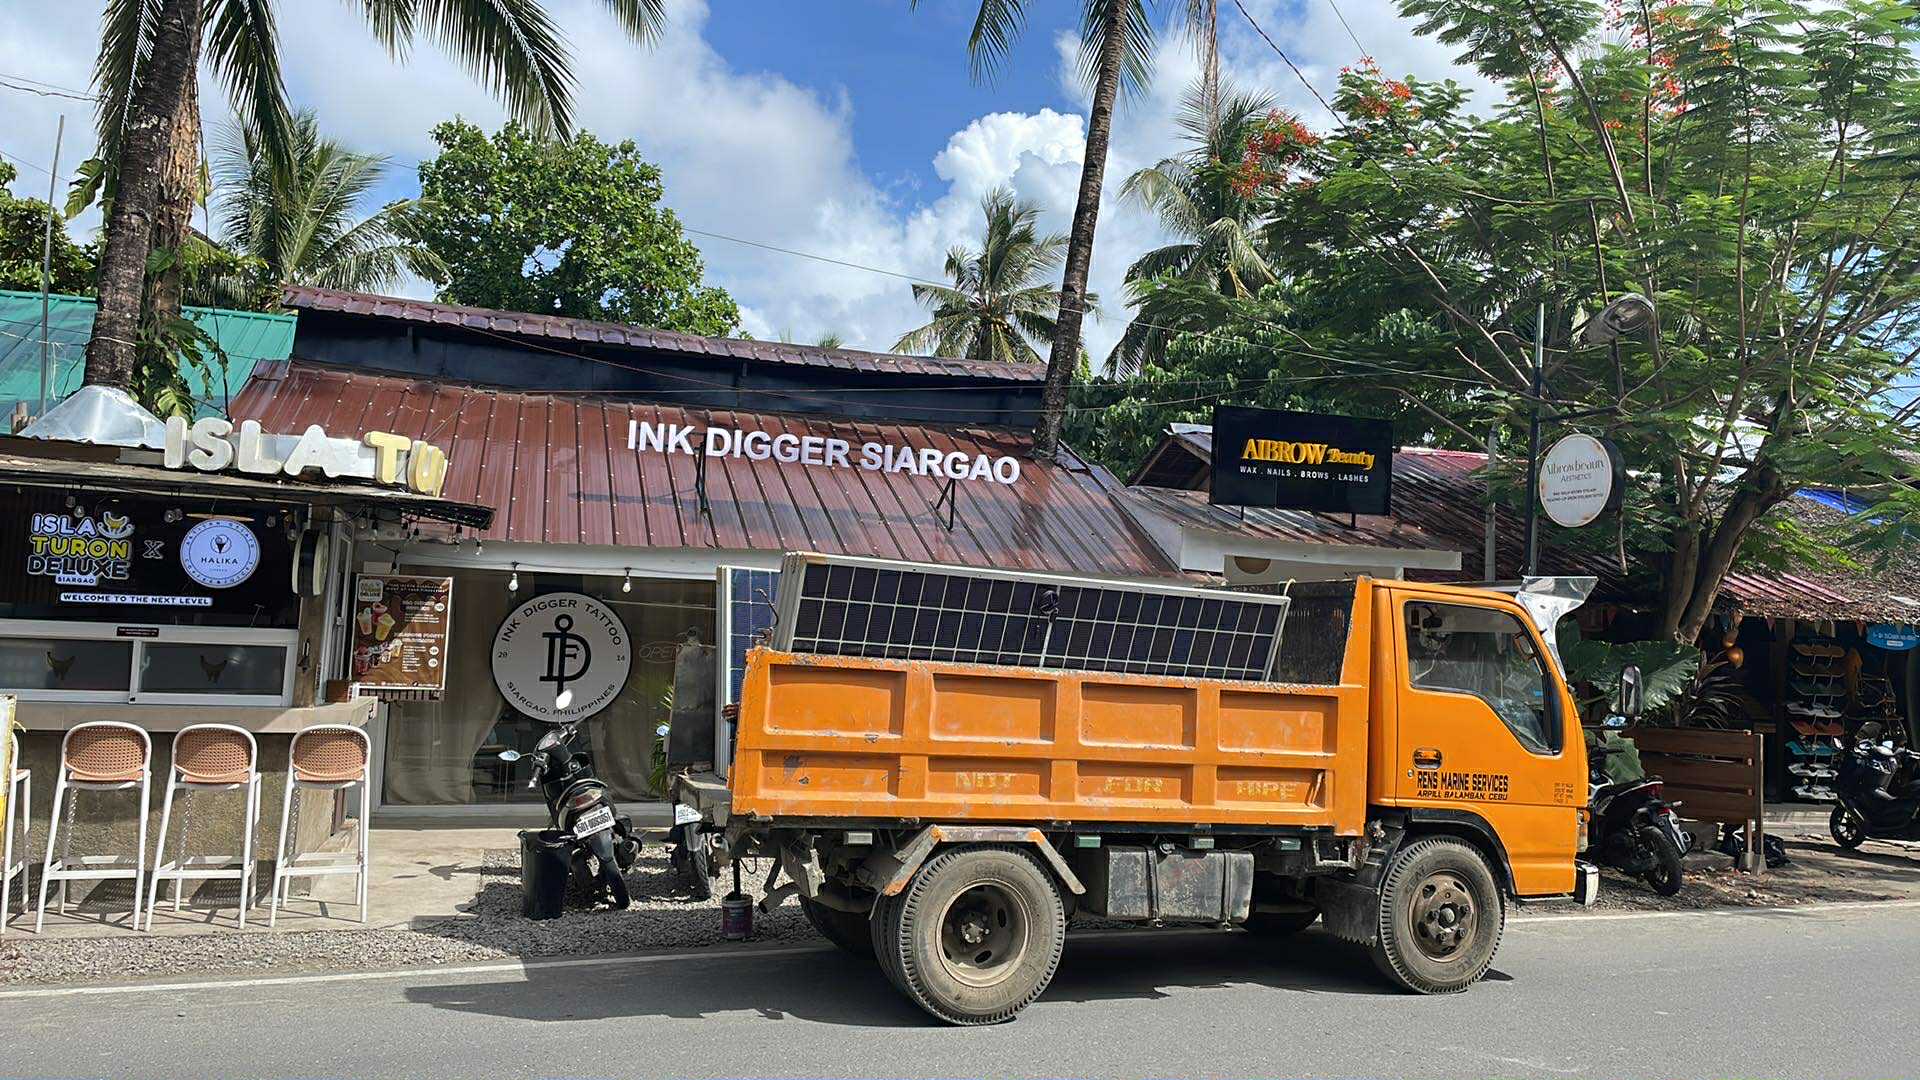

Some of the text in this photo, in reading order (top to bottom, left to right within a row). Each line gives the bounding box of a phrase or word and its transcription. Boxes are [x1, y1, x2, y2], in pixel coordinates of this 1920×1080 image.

[164, 416, 449, 498] ISLA TU
[627, 420, 1020, 484] INK DIGGER SIARGAO
[1327, 448, 1375, 470] Beauty
[1240, 466, 1369, 483] WAX NAILS BROWS LASHES
[32, 513, 97, 536] ISLA
[30, 535, 129, 560] TURON
[28, 555, 130, 579] DELUXE
[201, 556, 238, 565] HALIKA
[58, 576, 95, 584] SIARGAO
[63, 594, 110, 602] WELCOME
[179, 597, 209, 605] LEVEL
[501, 599, 622, 646] INK DIGGER TATTOO
[553, 683, 616, 716] PHILIPPINES
[1417, 770, 1509, 792] RENS MARINE SERVICES
[1488, 792, 1508, 801] CEBU
